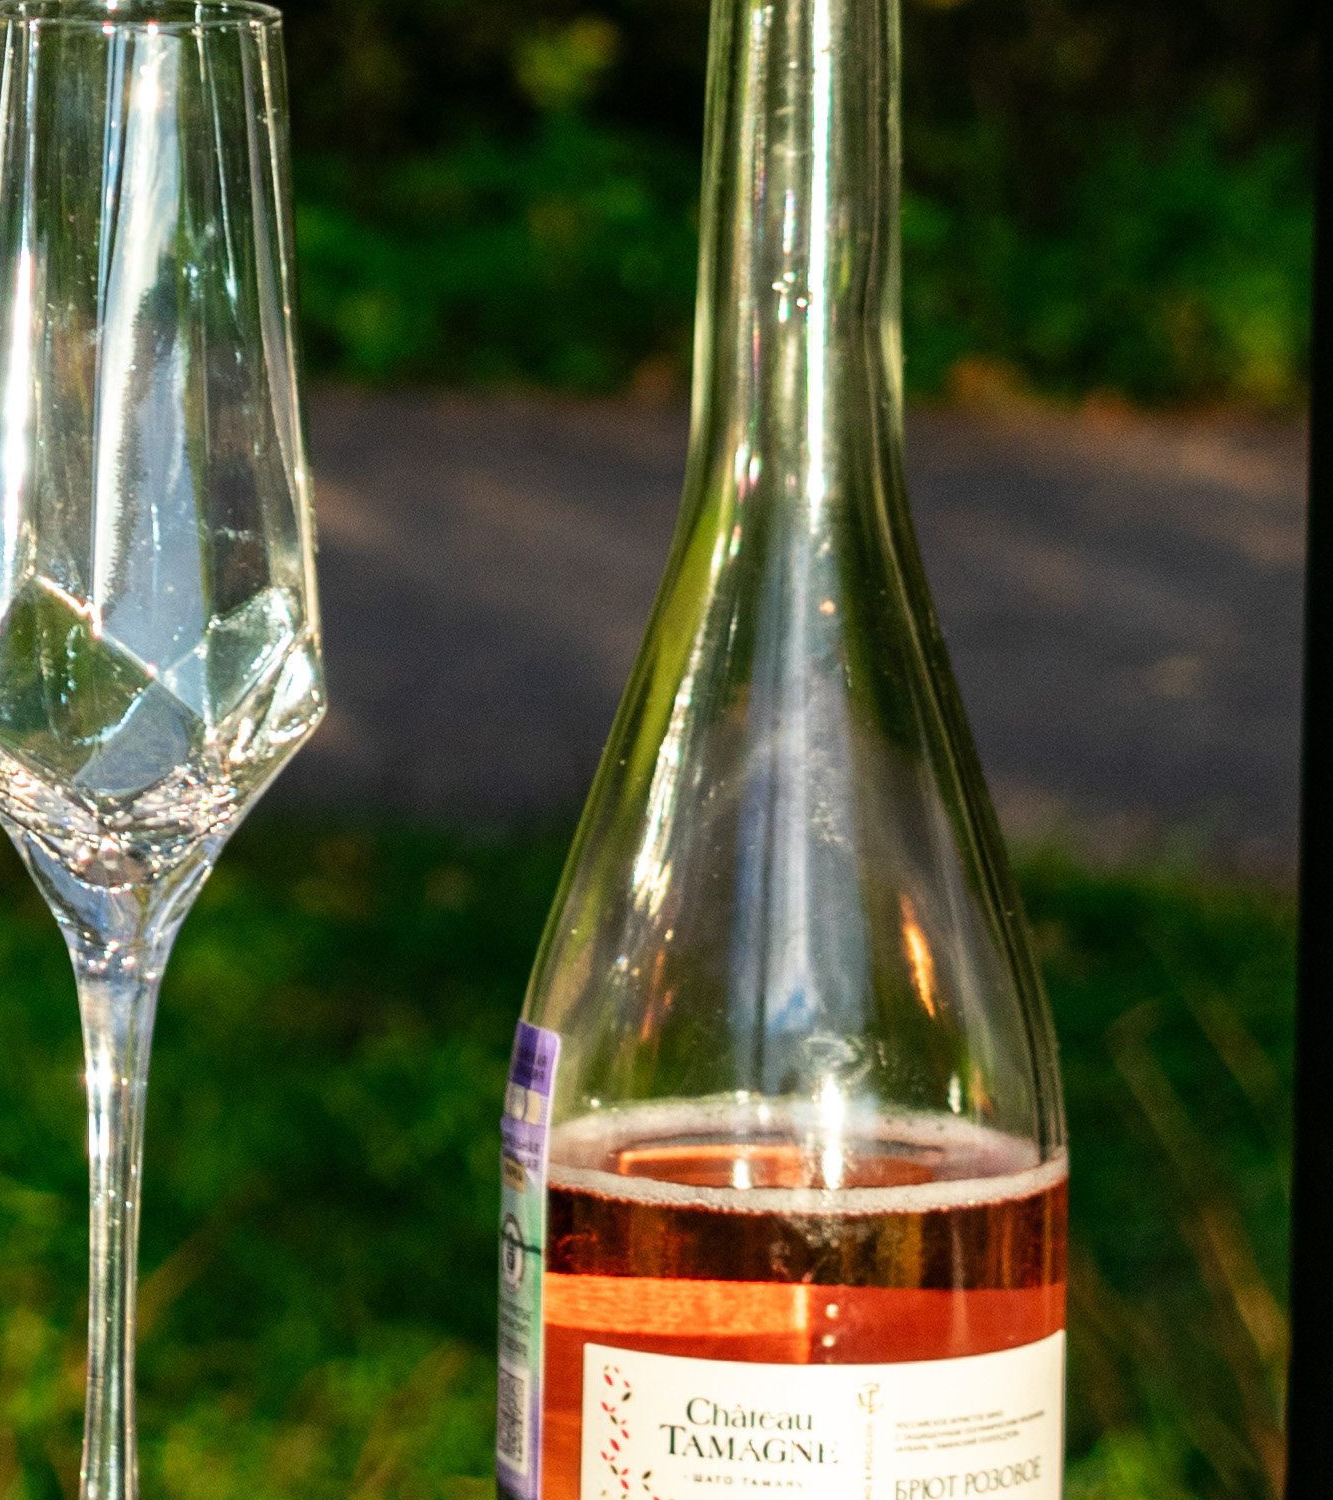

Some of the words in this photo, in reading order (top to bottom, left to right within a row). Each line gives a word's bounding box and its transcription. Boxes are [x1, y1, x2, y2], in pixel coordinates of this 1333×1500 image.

[686, 1397, 812, 1430] Château
[659, 1424, 839, 1464] TAMAGNE
[965, 1456, 1042, 1496] РОЗОВОЕ
